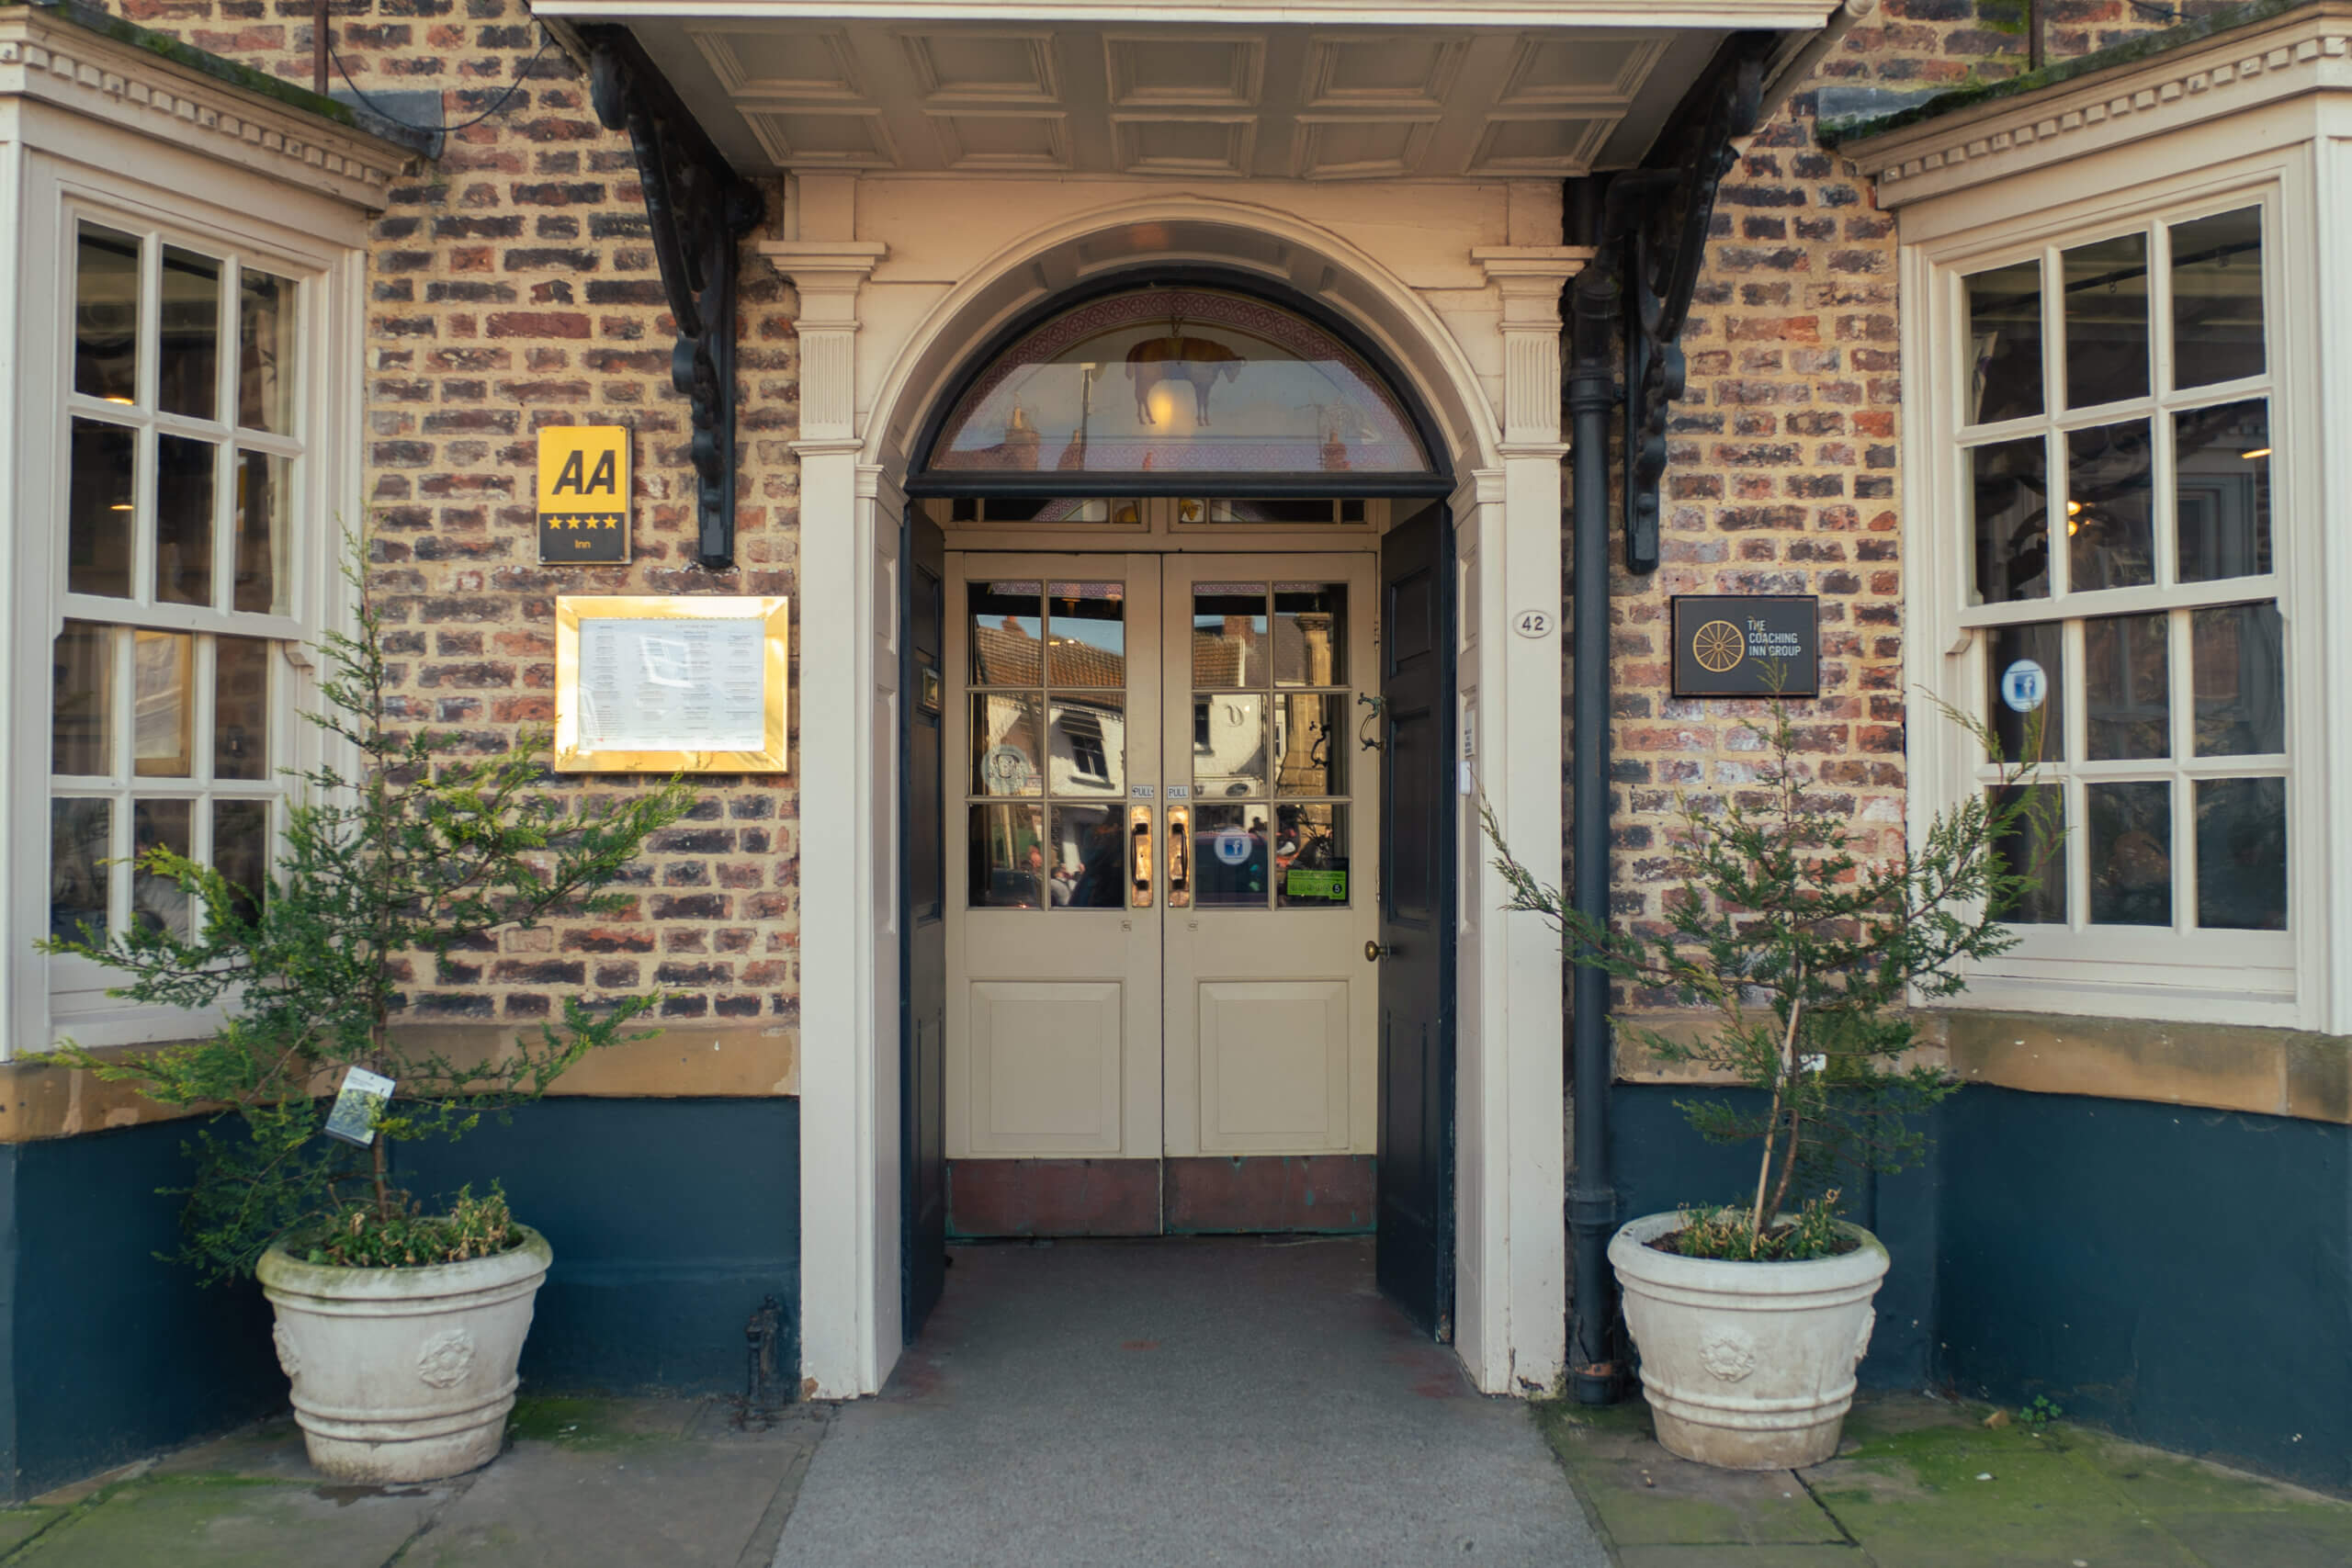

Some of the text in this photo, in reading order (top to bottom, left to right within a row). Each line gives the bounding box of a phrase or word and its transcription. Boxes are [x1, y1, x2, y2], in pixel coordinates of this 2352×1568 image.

[551, 449, 616, 495] AA
[574, 539, 592, 549] Inn
[1521, 615, 1544, 632] 42
[1747, 619, 1766, 631] THE
[1748, 632, 1798, 644] COACHING
[1748, 645, 1802, 656] INN GROUP
[1133, 787, 1152, 797] PULL
[1169, 787, 1187, 797] PULL
